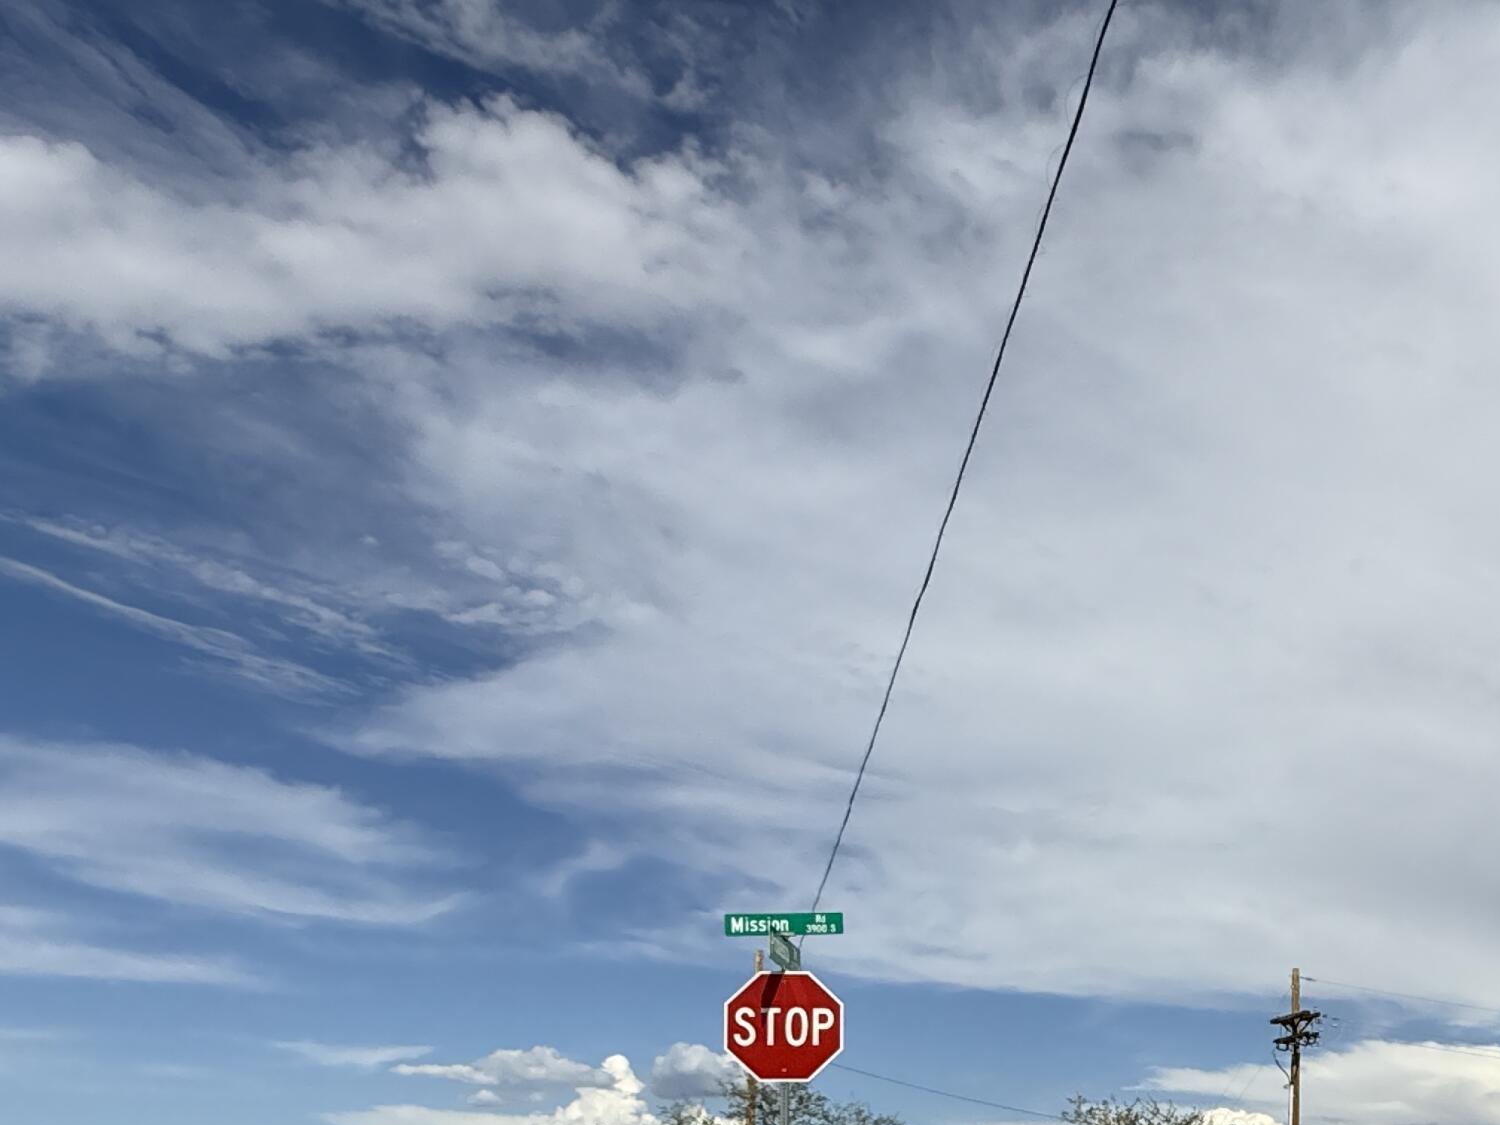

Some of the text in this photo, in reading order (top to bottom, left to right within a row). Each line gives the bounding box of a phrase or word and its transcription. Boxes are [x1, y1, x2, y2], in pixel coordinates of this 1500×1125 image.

[731, 916, 789, 932] Mission
[815, 914, 826, 923] Rd
[733, 1006, 834, 1047] STOP
